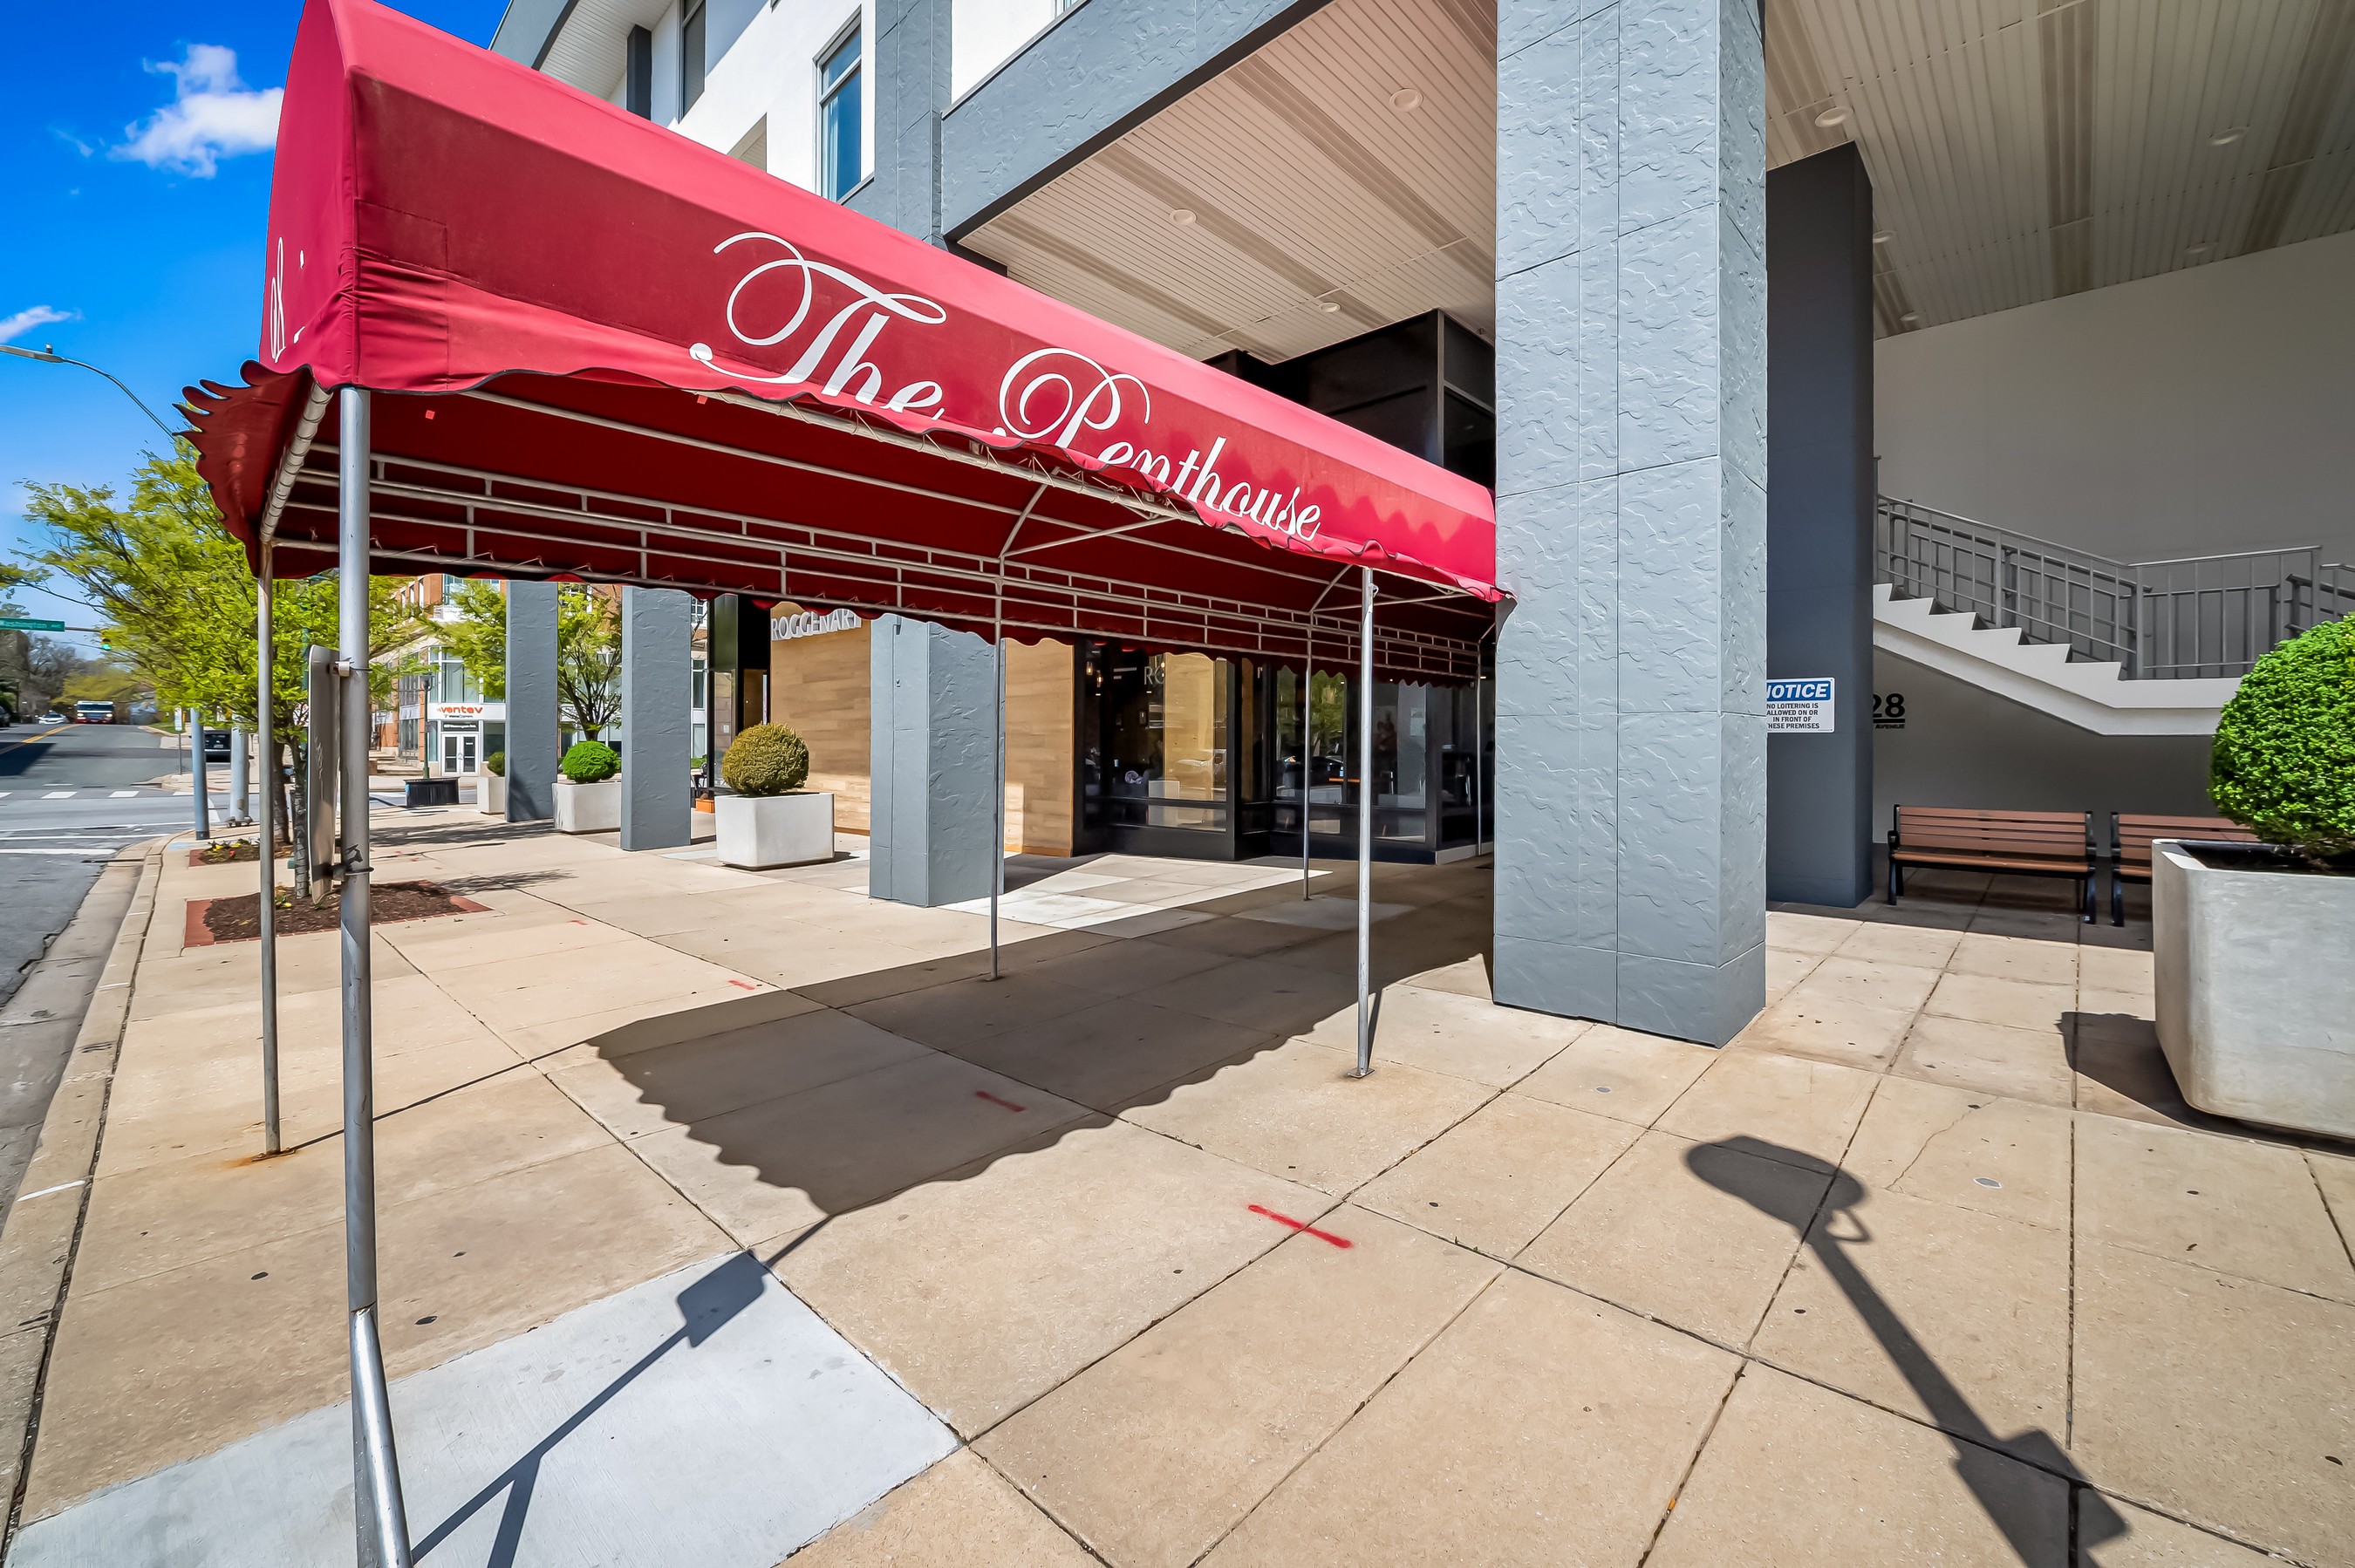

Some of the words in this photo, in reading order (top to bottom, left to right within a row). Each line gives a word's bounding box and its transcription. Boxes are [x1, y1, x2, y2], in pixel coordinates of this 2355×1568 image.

[689, 231, 947, 420] The
[992, 347, 1321, 542] Penthouse
[1873, 693, 1905, 718] 28
